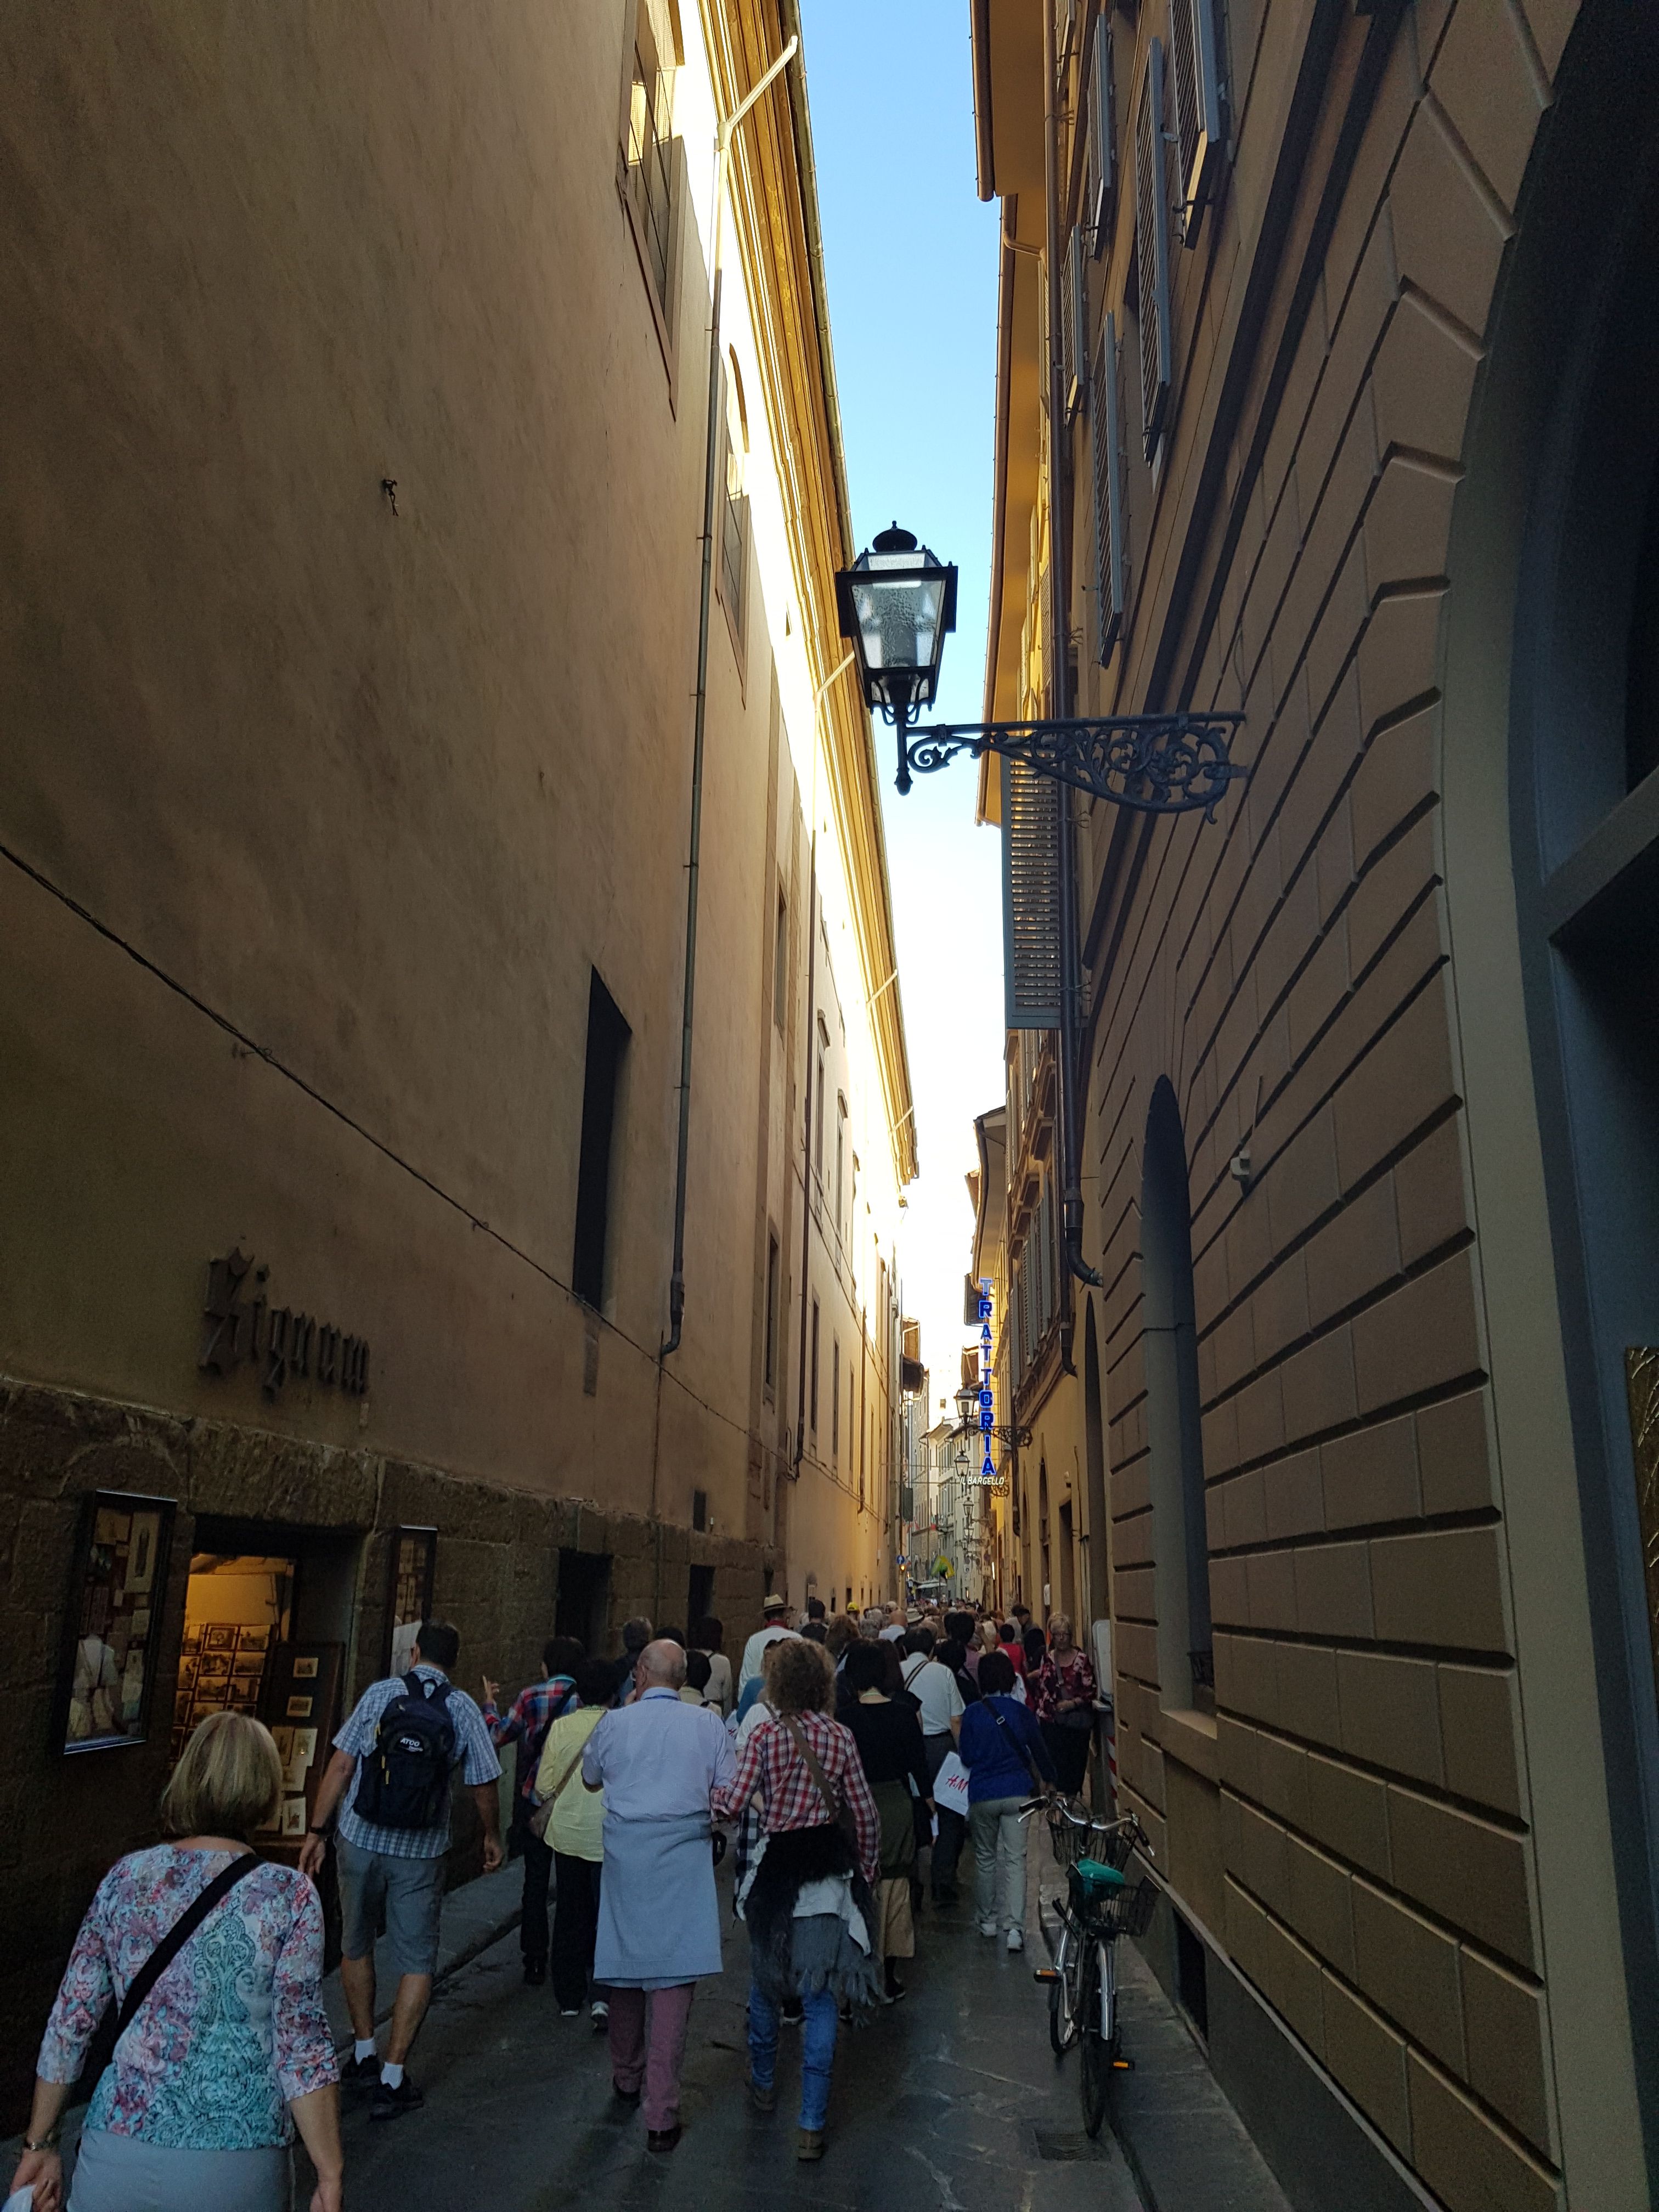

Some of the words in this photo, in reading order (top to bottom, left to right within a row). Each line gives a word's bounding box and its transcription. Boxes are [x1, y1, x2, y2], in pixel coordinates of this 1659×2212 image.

[978, 1278, 995, 1475] TRATTORIA
[960, 1476, 966, 1485] IL
[967, 1476, 1005, 1485] BARGELLO
[945, 1774, 969, 1793] H&M
